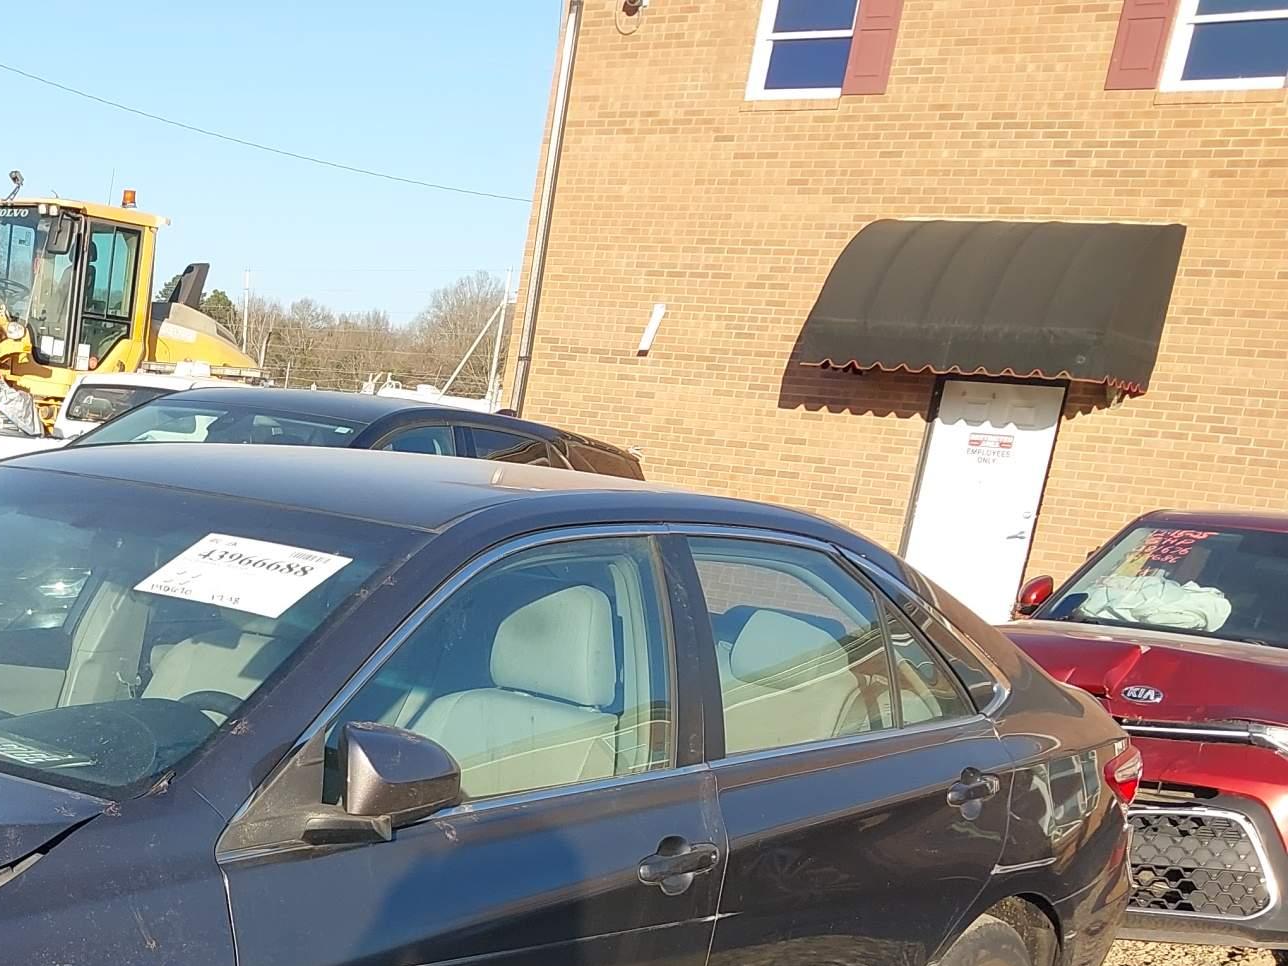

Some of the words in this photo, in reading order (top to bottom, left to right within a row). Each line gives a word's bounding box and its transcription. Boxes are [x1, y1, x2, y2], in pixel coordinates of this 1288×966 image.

[967, 448, 1011, 458] EMPLOYEES
[198, 549, 314, 576] 43966688
[1127, 688, 1154, 700] KIA
